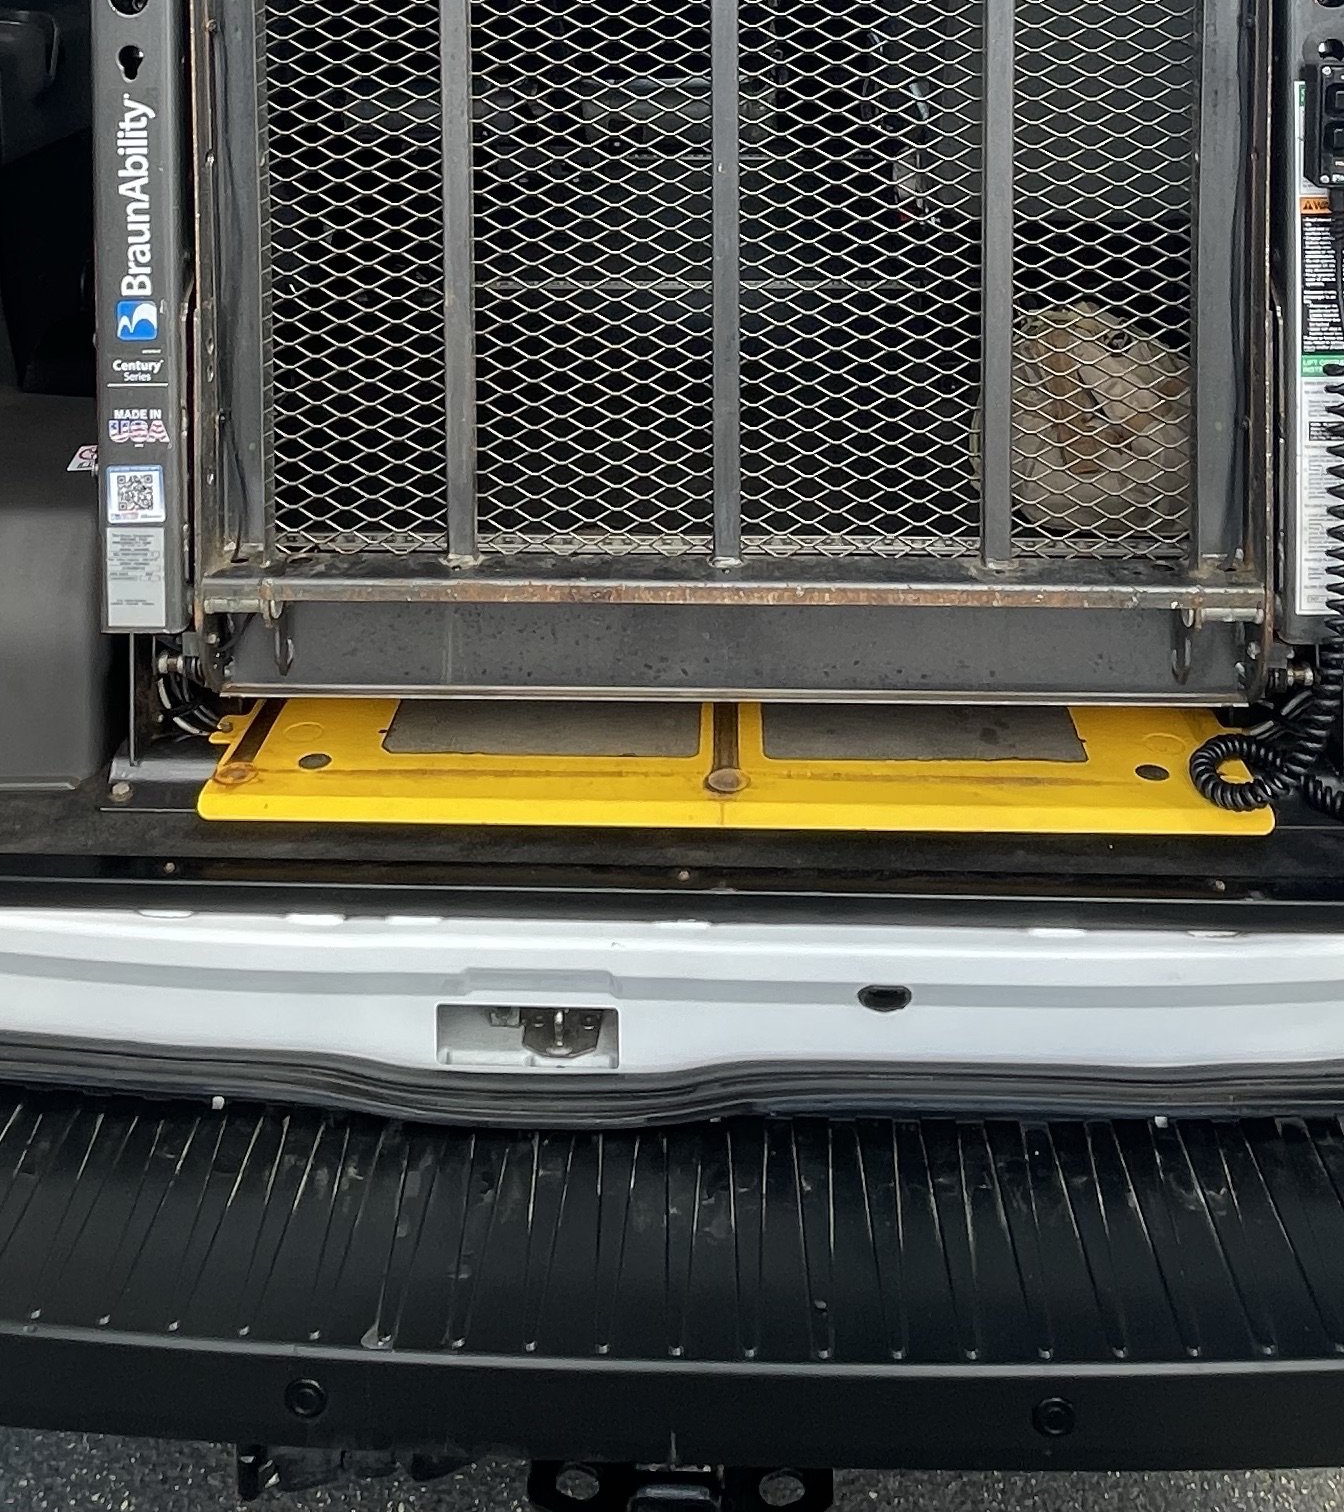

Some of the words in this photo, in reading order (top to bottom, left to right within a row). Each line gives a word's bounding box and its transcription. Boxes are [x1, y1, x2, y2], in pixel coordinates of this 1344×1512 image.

[117, 95, 156, 297] BraunAbility
[112, 359, 164, 374] Century
[123, 372, 152, 382] Series
[113, 409, 148, 420] MADE
[149, 409, 162, 420] IN
[108, 419, 171, 443] USA
